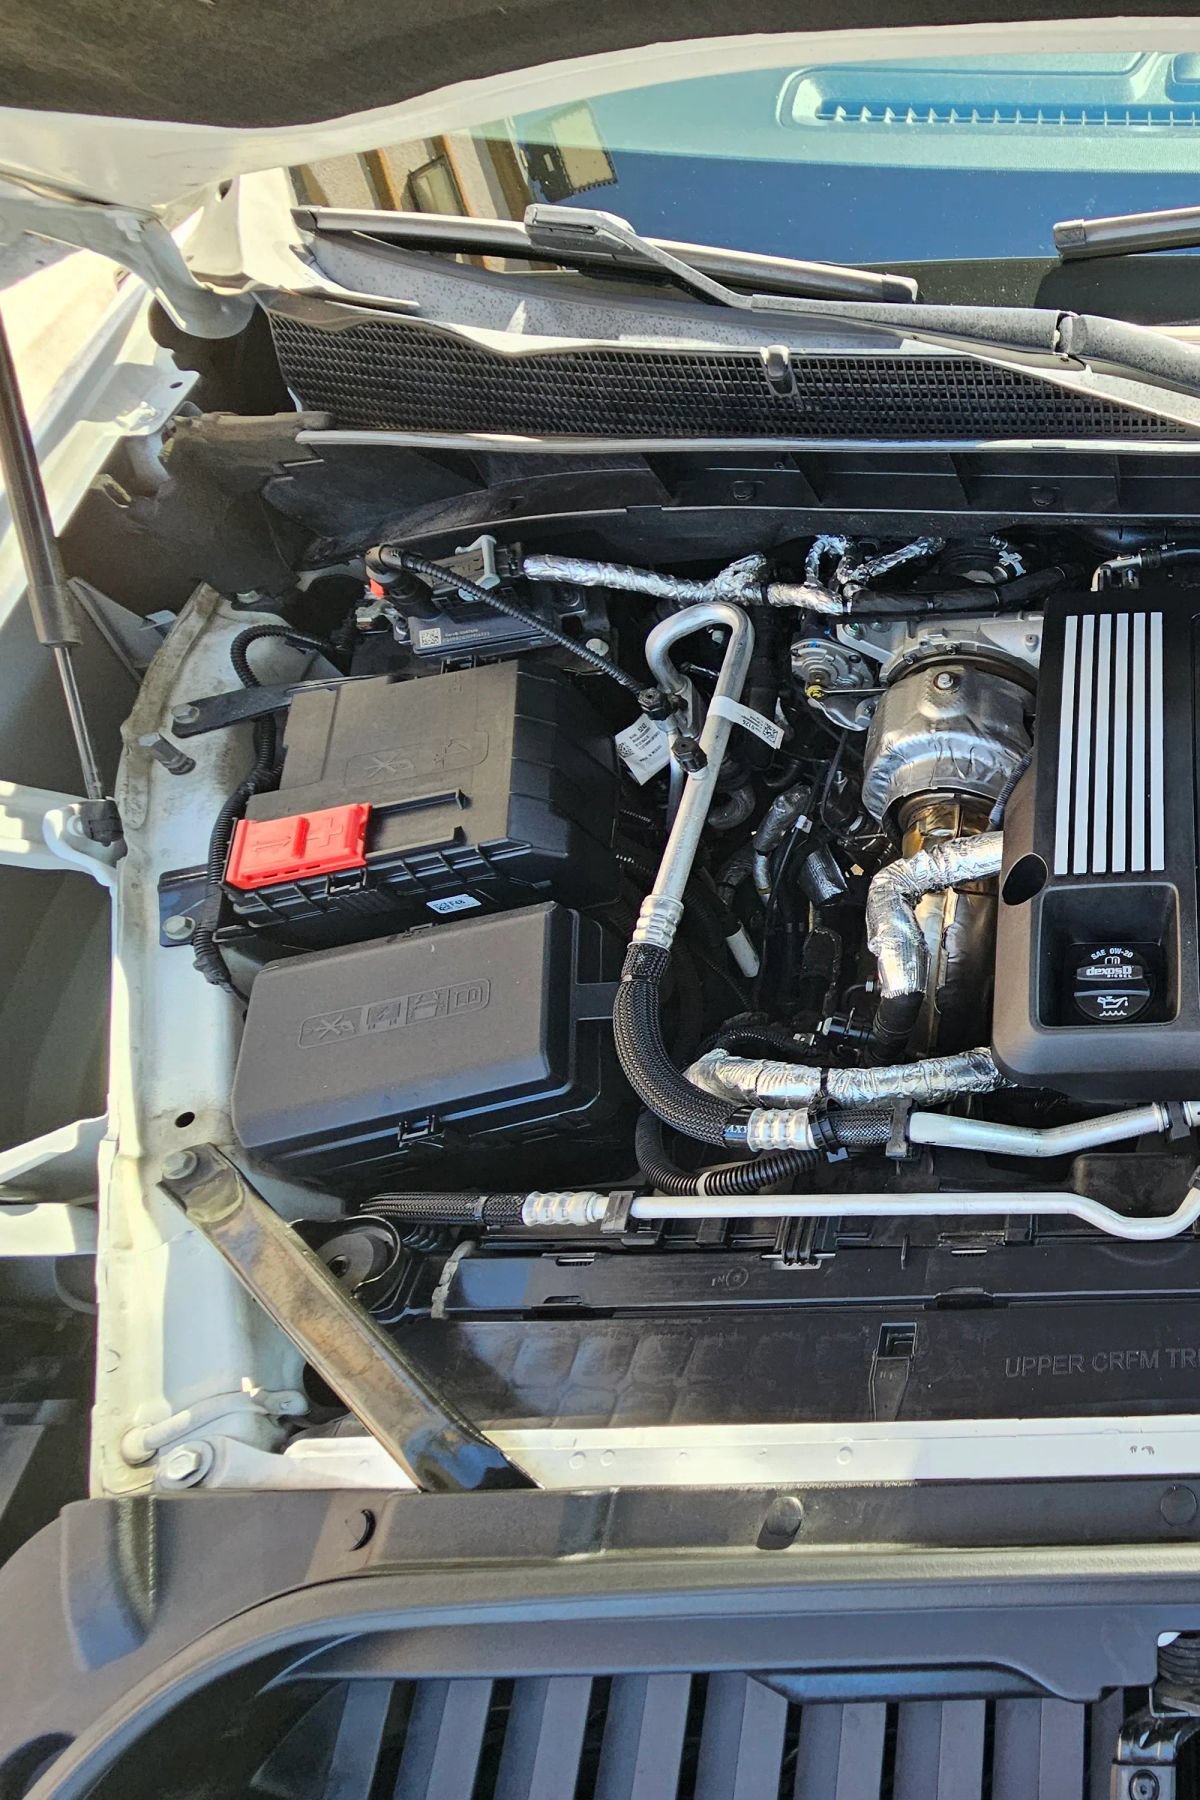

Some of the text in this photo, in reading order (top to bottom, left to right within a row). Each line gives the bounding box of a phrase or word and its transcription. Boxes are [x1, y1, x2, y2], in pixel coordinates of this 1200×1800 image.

[1091, 947, 1134, 960] SAE 0W-20
[1004, 1354, 1086, 1378] UPPER
[1091, 1349, 1160, 1372] CRFM
